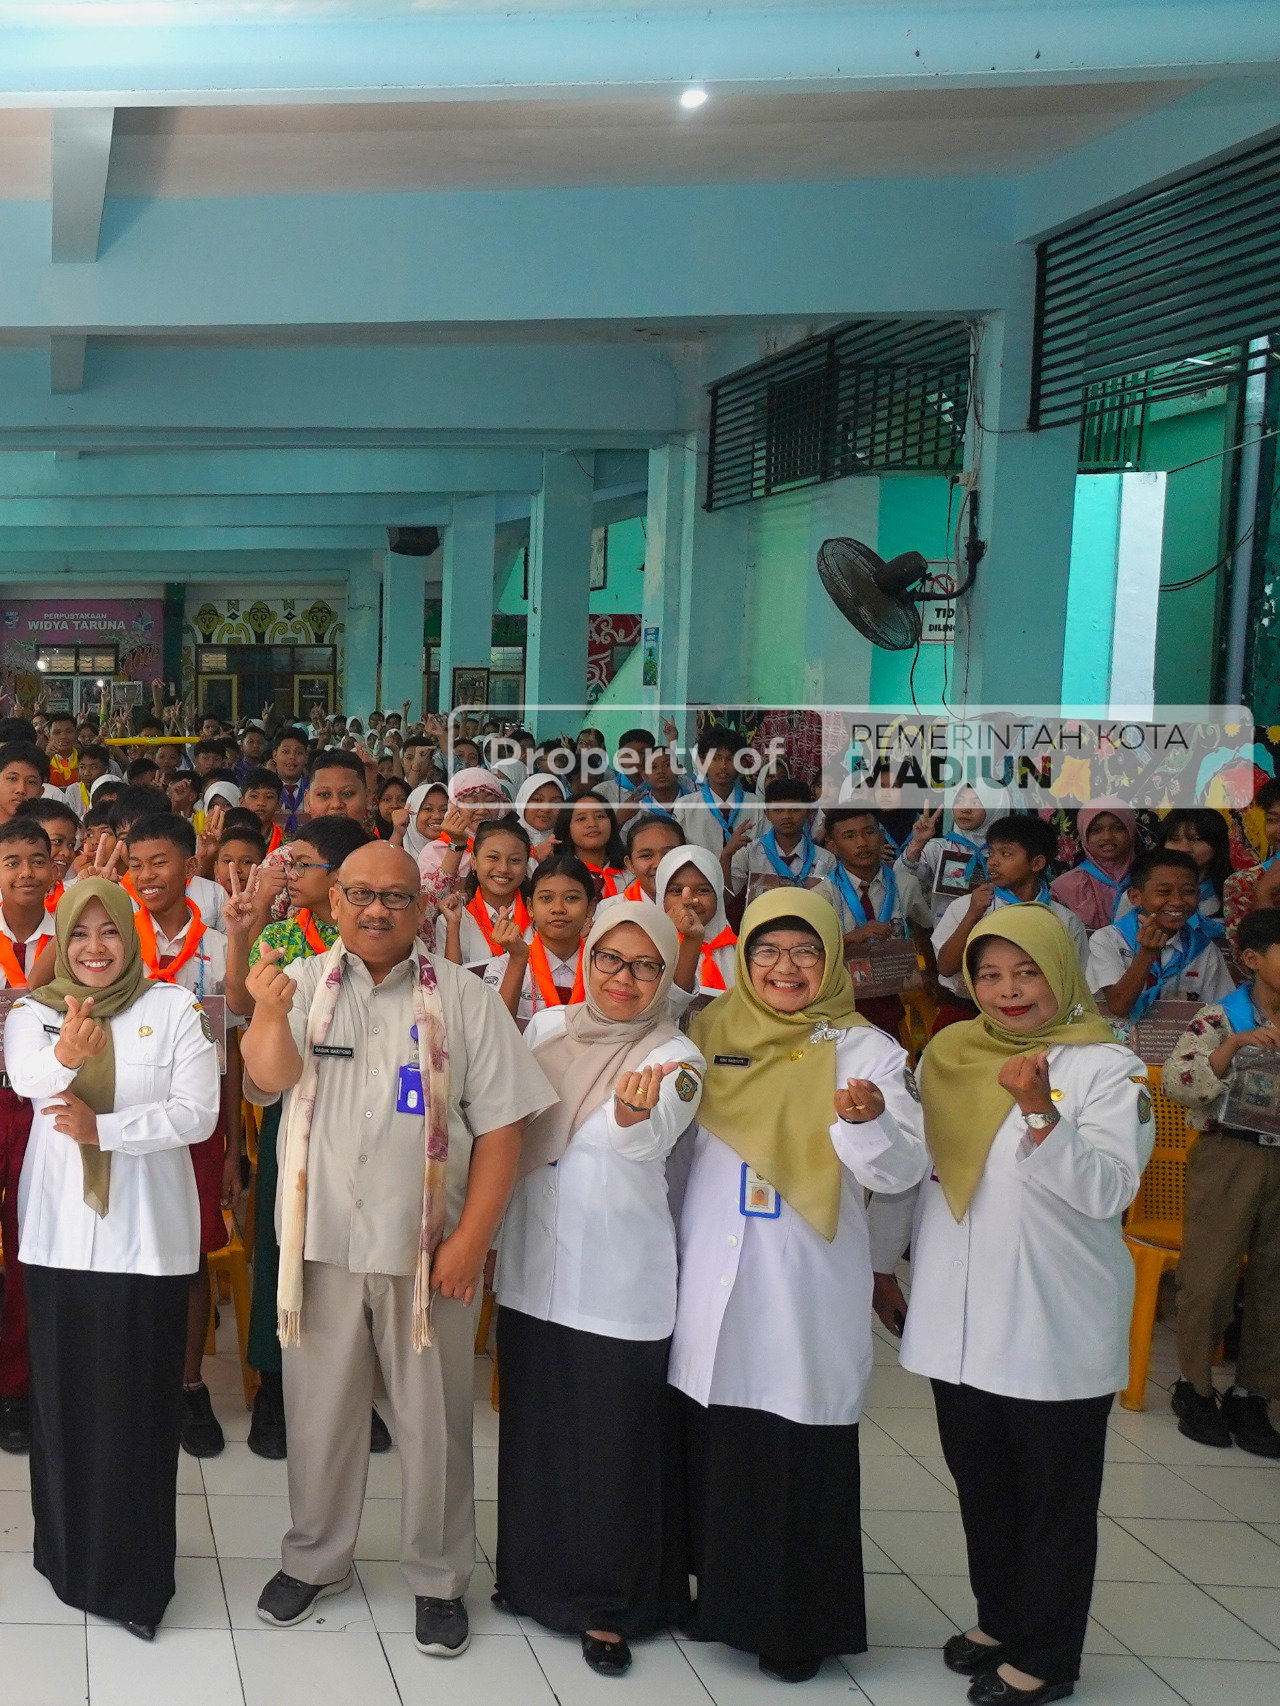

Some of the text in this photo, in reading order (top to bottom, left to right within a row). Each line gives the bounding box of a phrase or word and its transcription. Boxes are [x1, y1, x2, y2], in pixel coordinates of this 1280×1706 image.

[935, 608, 955, 618] TID
[27, 621, 126, 630] WIDYA TARUNA
